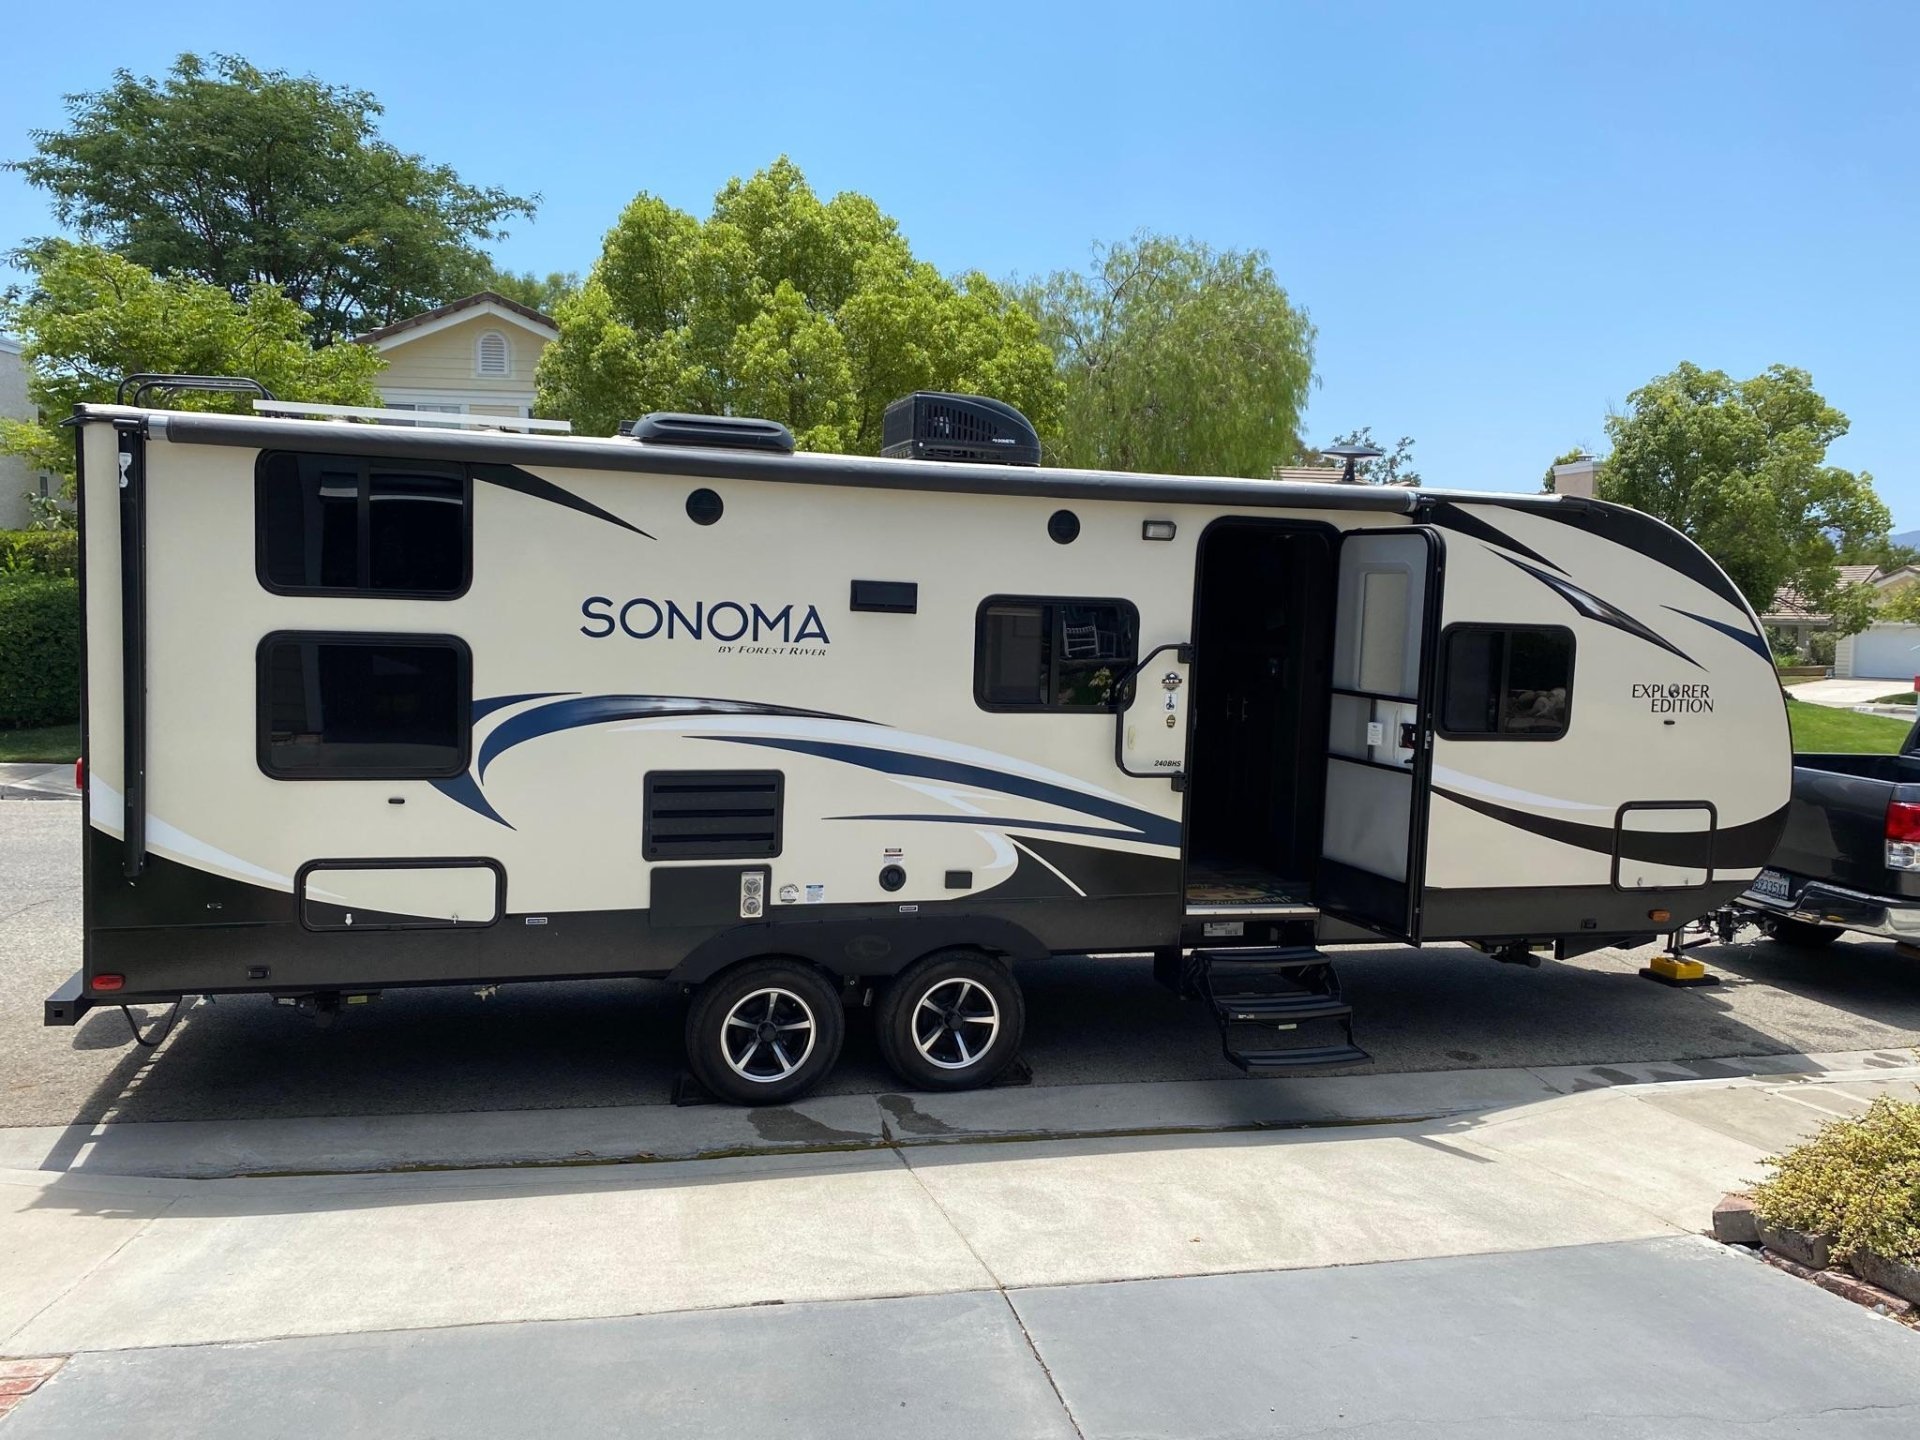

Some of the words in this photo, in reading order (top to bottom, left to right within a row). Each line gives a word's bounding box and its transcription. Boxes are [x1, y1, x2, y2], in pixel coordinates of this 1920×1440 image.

[580, 596, 831, 644] SONOMA
[717, 645, 734, 654] BY
[738, 645, 787, 656] FOREST
[789, 647, 827, 657] RIVER
[1631, 683, 1710, 699] EXPLORER
[1650, 698, 1715, 713] EDITION
[1153, 759, 1182, 767] 240BHS
